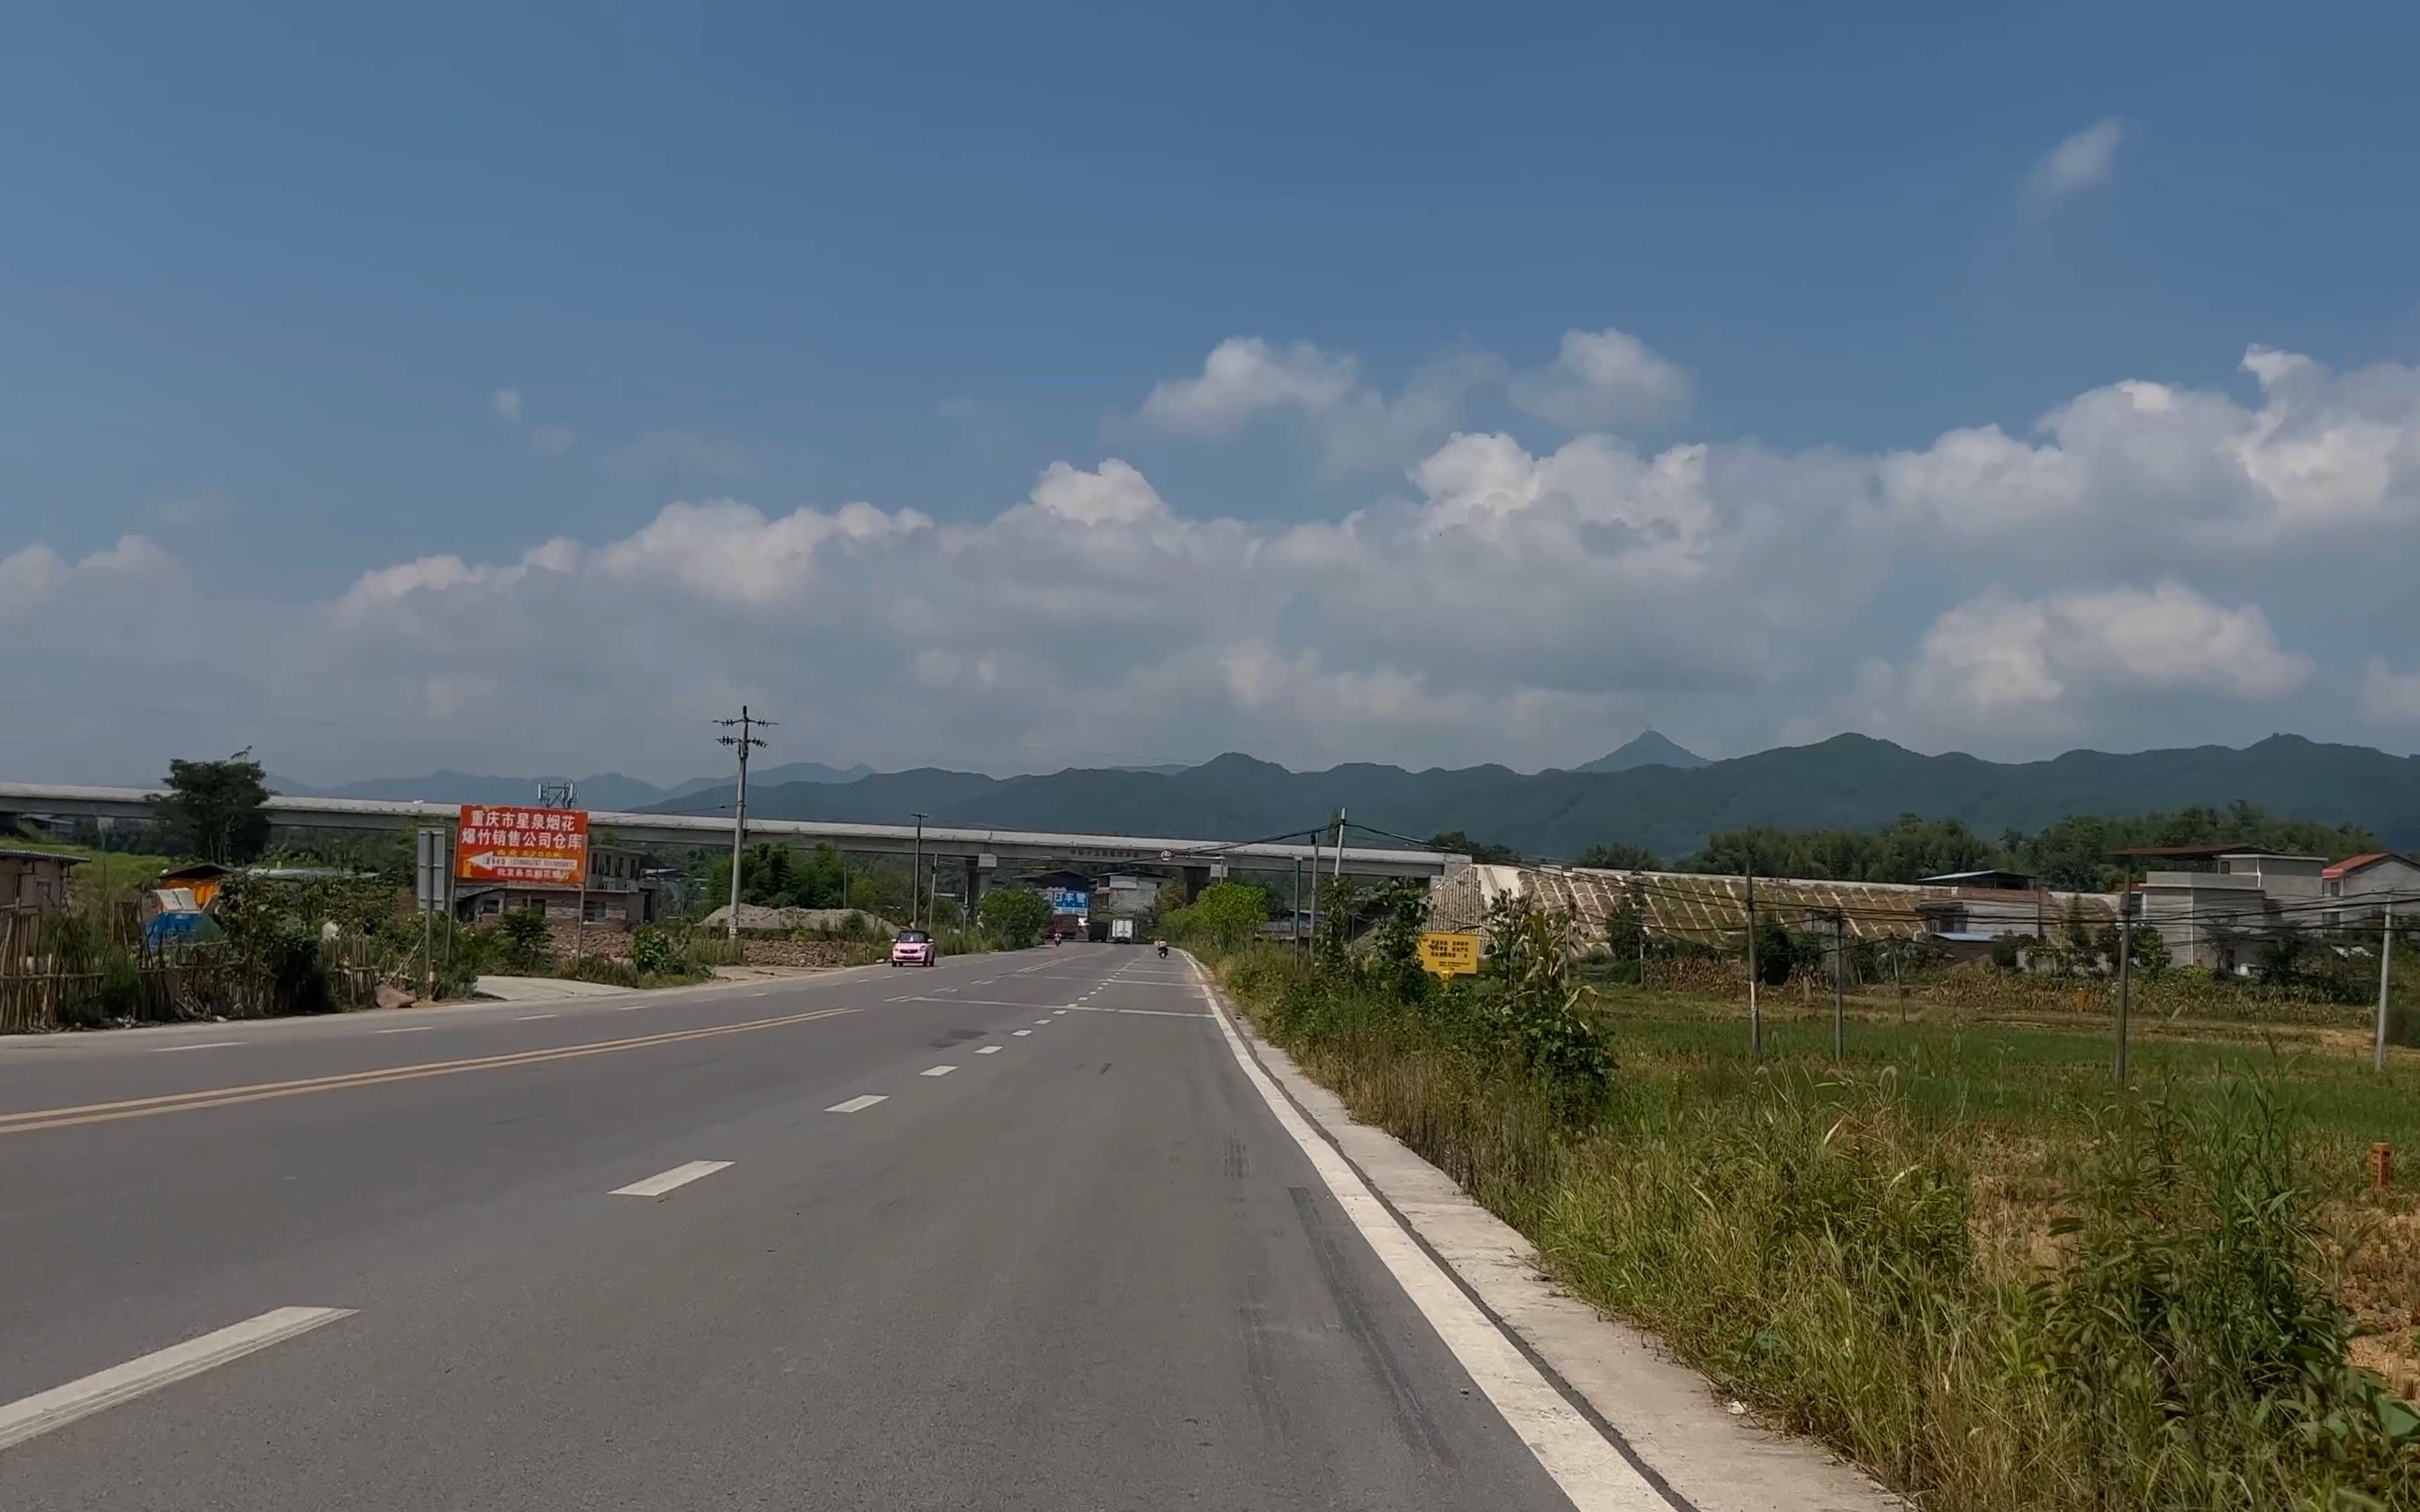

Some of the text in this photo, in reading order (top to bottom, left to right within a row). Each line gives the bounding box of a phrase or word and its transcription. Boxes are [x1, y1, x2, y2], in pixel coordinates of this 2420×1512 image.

[470, 810, 575, 831] 重庆市星泉烟花
[462, 828, 582, 850] 爆竹销售公司仓库
